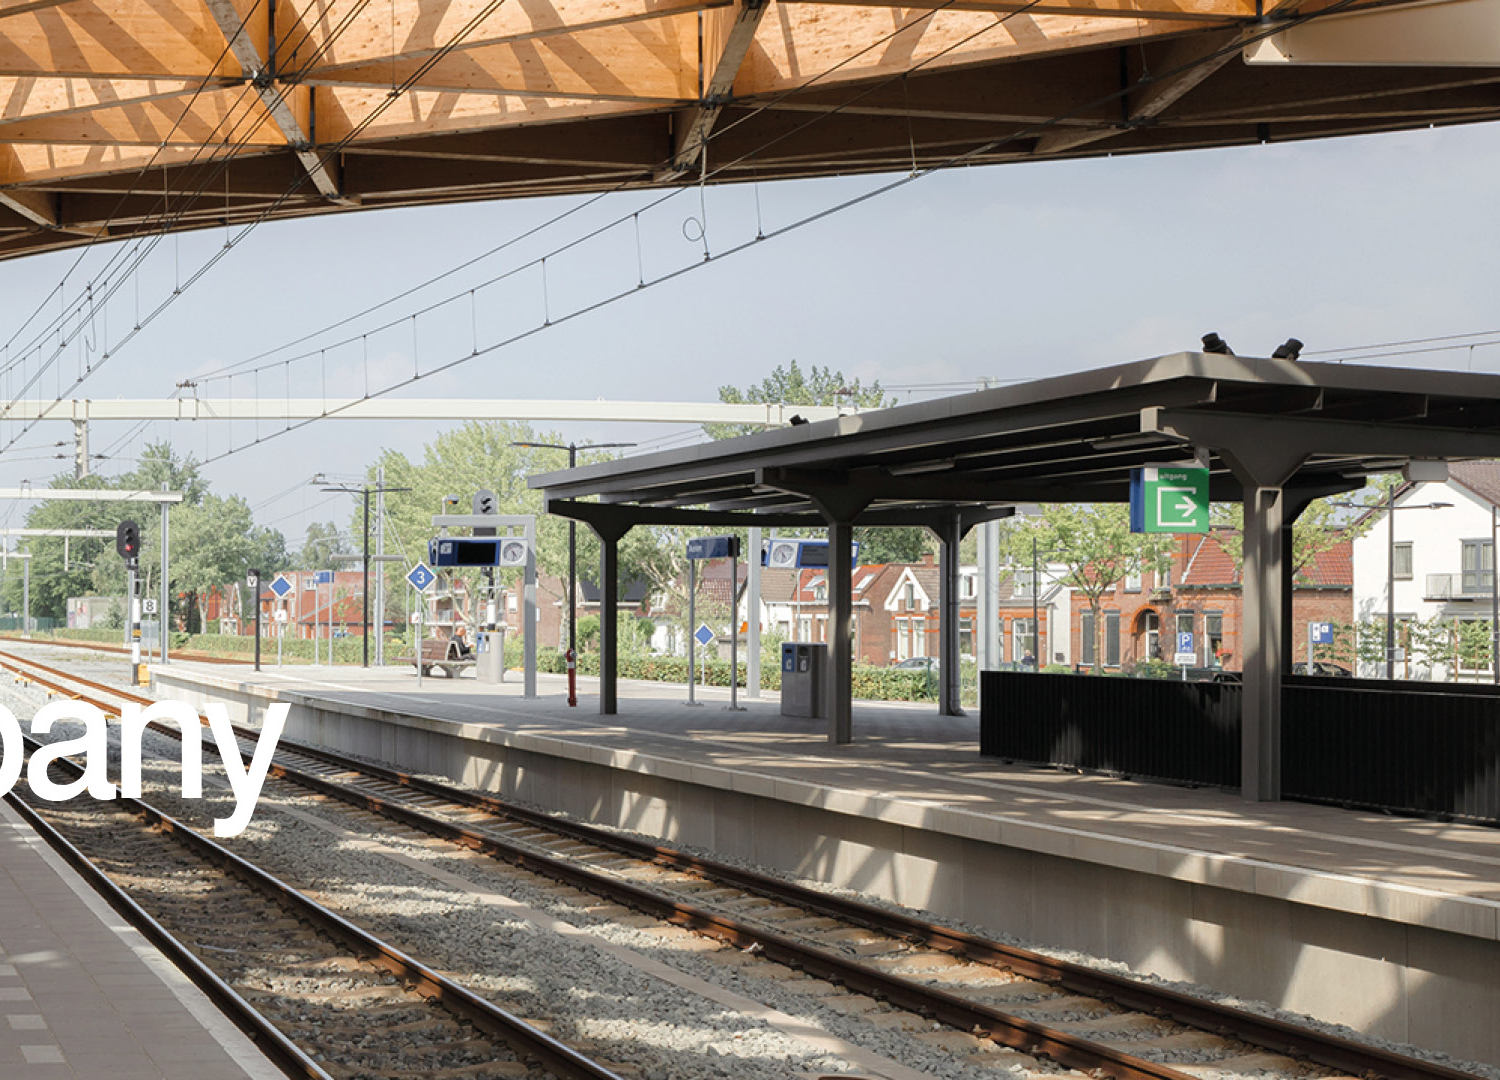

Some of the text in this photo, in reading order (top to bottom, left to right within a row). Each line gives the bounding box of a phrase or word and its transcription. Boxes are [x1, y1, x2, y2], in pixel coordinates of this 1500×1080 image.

[1159, 473, 1187, 481] uitgang
[416, 571, 425, 584] 3
[145, 600, 155, 612] 8
[1181, 634, 1191, 646] P
